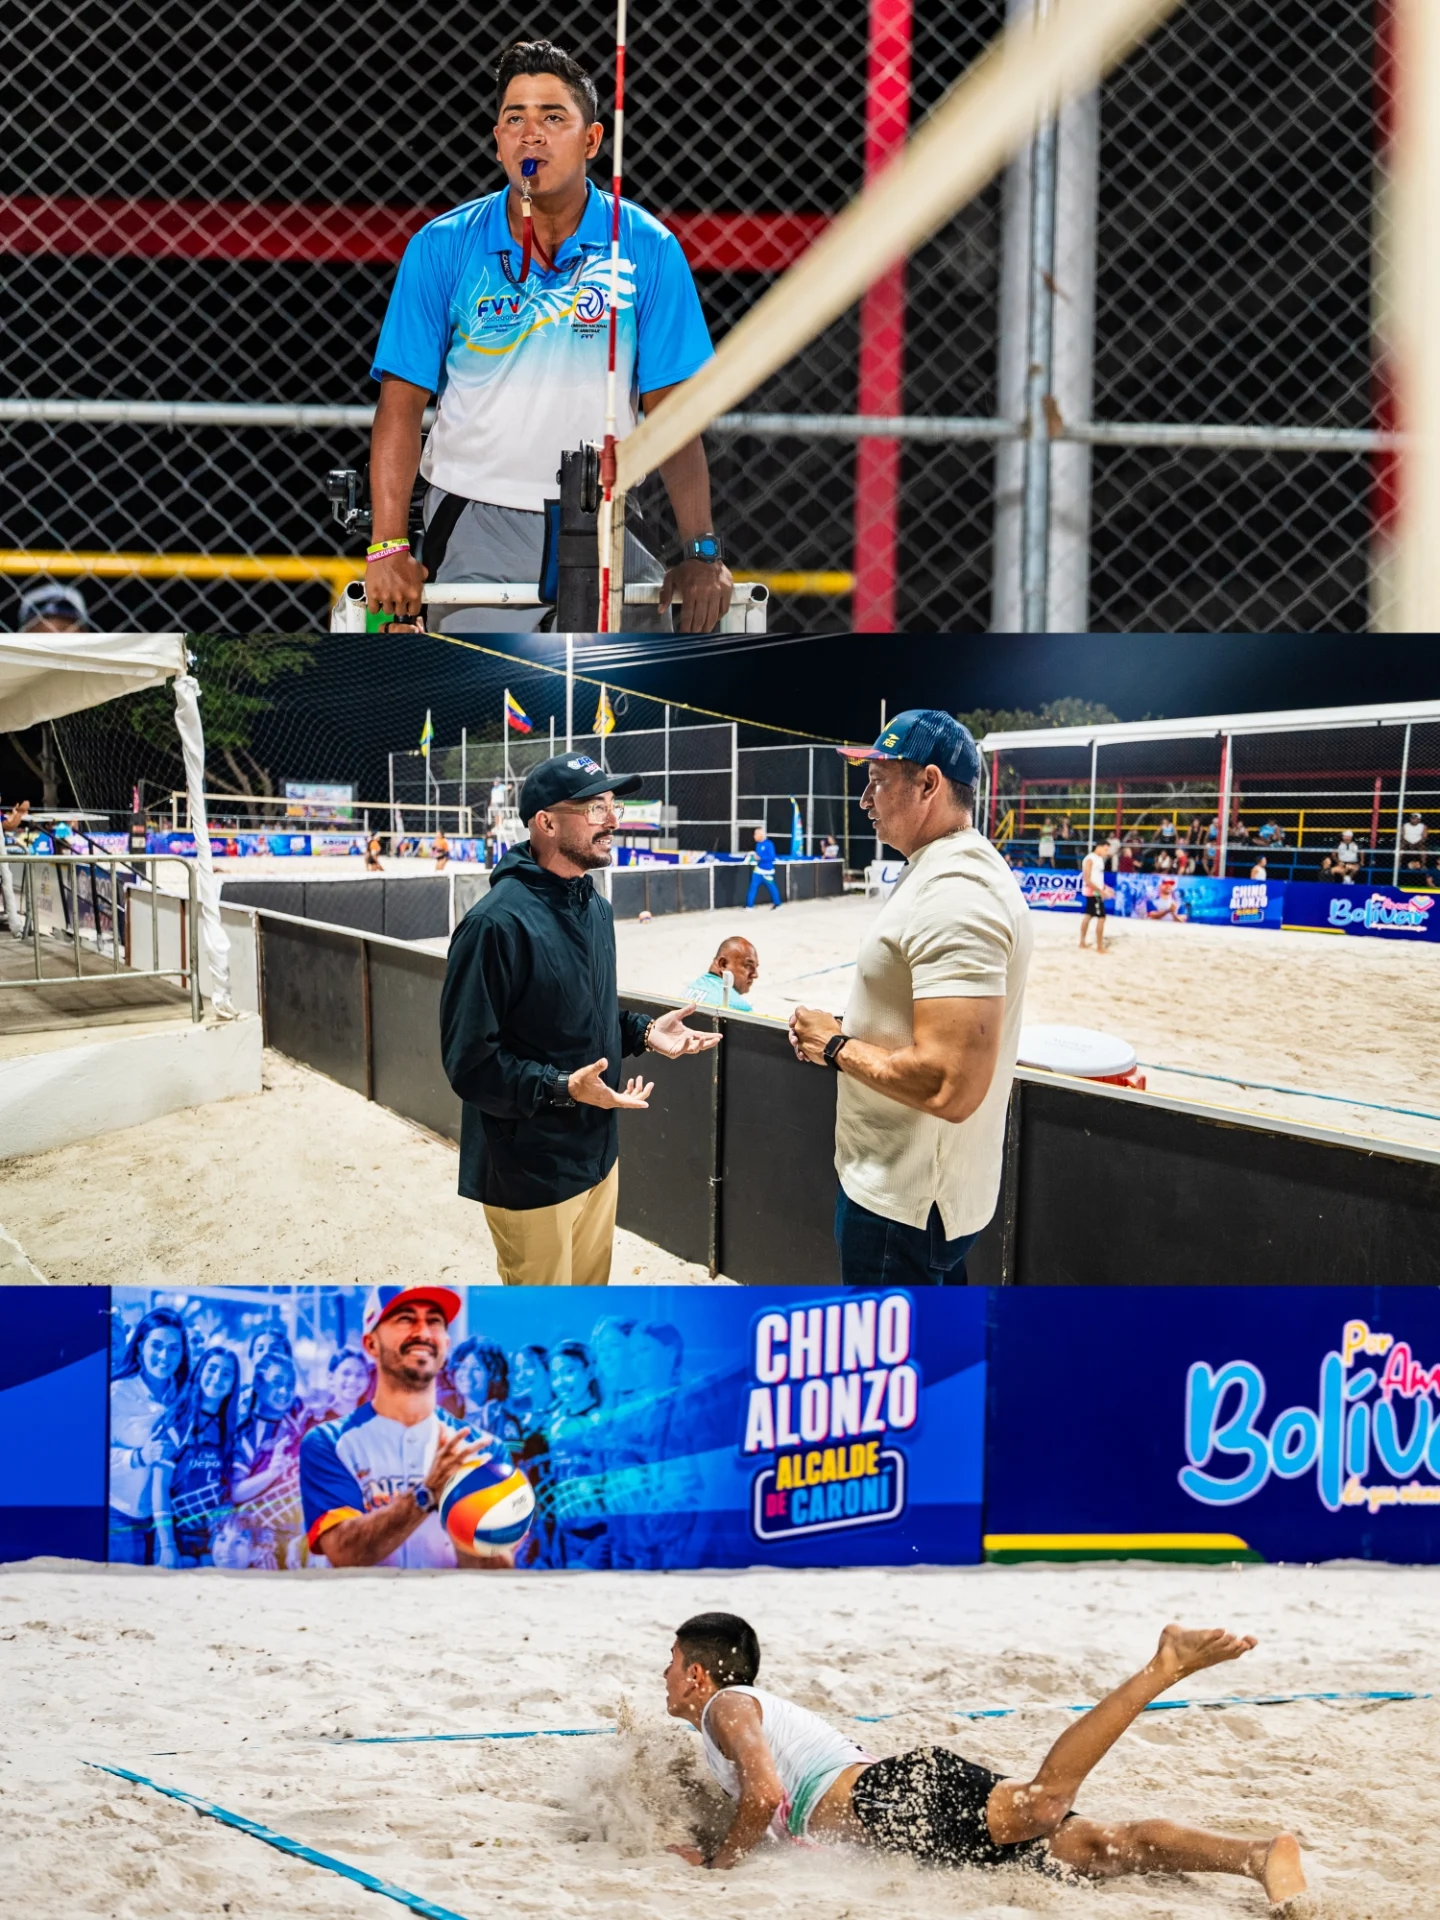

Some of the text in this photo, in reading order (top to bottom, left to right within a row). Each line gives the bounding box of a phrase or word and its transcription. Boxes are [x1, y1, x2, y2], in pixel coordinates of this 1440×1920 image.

[477, 293, 520, 317] FVV
[1232, 884, 1267, 899] CHINO
[755, 1295, 911, 1384] CHINO
[1343, 1319, 1394, 1367] Por
[744, 1365, 918, 1453] ALONZO
[775, 1441, 881, 1492] ALCALDE
[765, 1465, 894, 1526] DE CARONÍ
